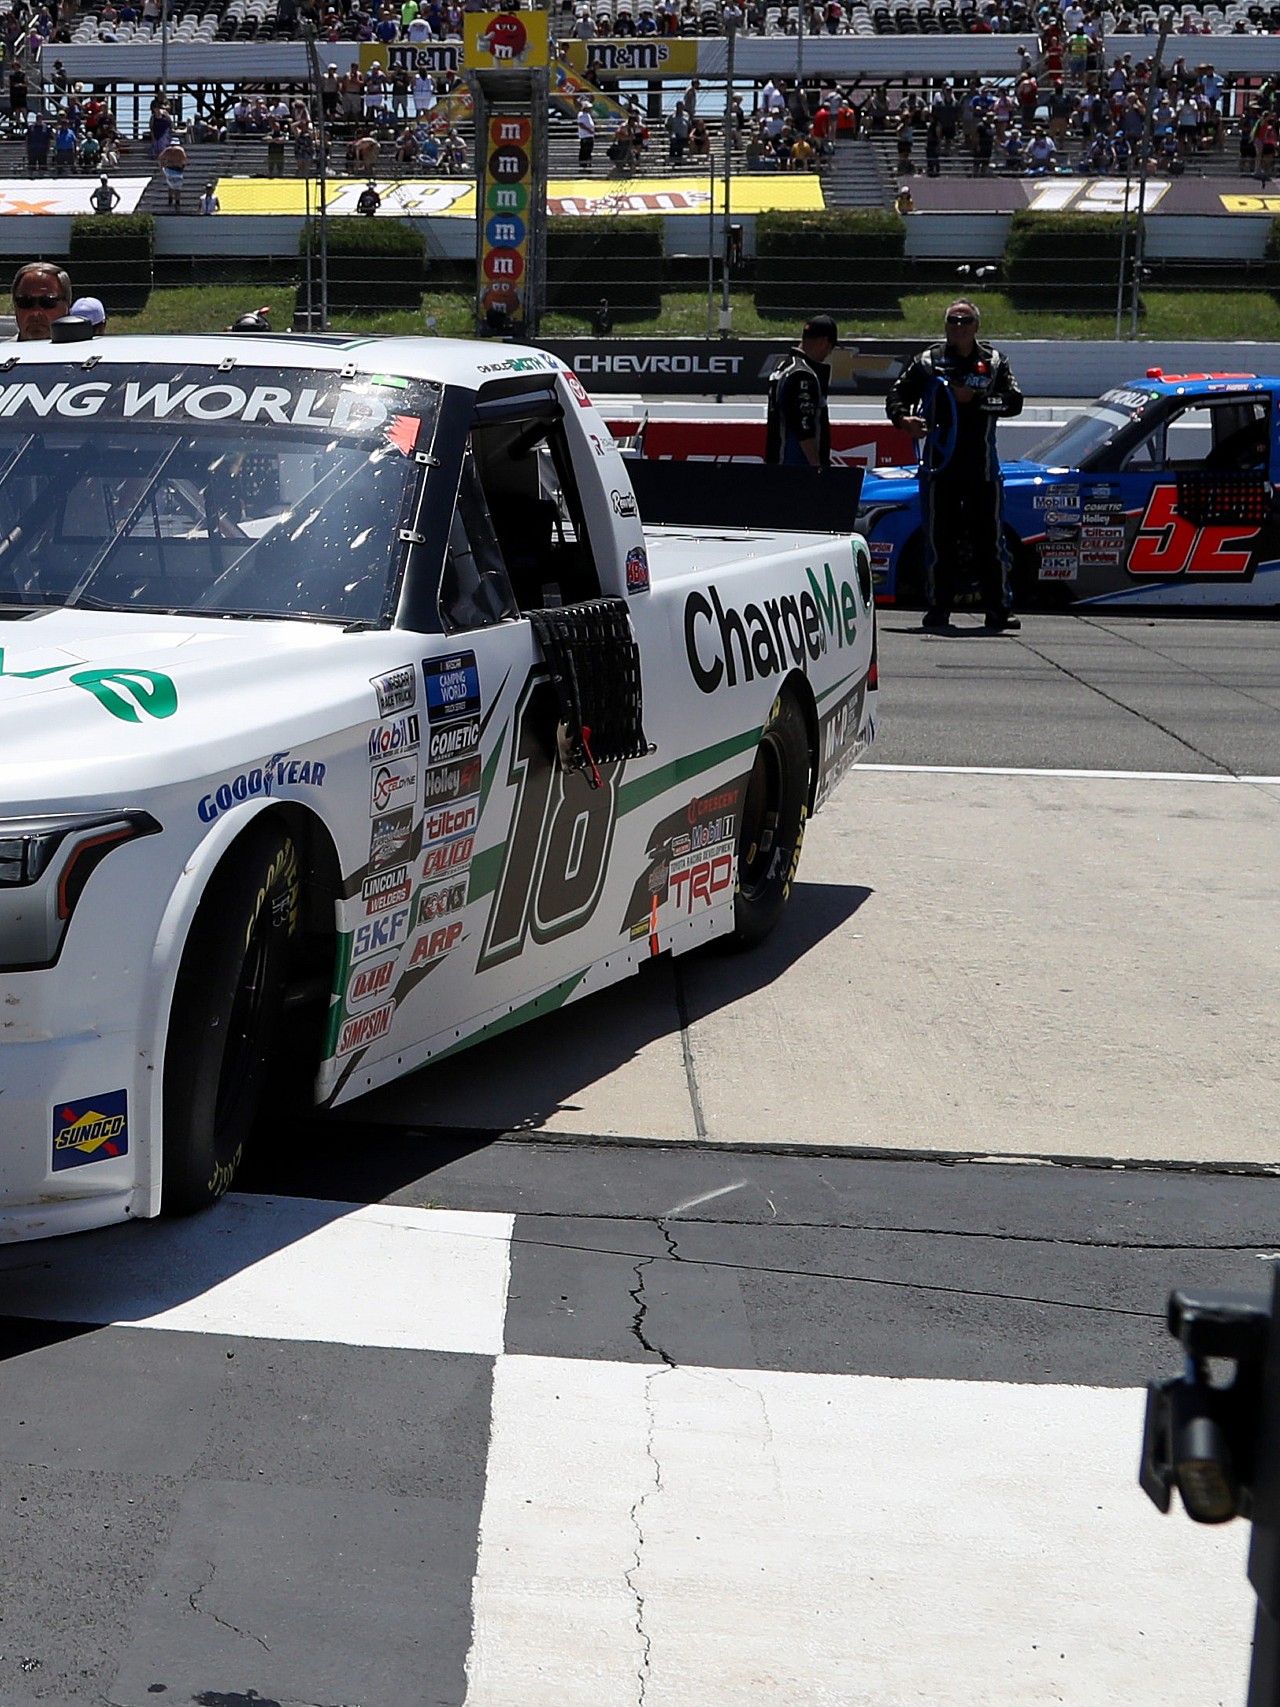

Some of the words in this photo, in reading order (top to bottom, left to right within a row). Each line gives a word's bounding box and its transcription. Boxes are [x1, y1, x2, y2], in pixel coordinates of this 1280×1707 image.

[586, 43, 669, 71] m&m's
[500, 123, 521, 140] m
[498, 156, 519, 173] m
[496, 190, 518, 207] m
[1029, 179, 1171, 211] 19
[494, 224, 516, 240] m
[492, 258, 514, 273] m
[573, 355, 744, 374] CHEVROLET
[119, 382, 389, 431] WORLD
[1129, 485, 1260, 574] 52
[439, 670, 466, 687] CAMPING
[441, 683, 468, 702] WORLD
[368, 718, 408, 756] Mobil
[430, 723, 480, 757] COMETIC
[425, 767, 461, 797] Holley
[426, 806, 476, 840] tilton
[691, 818, 722, 850] Mobil
[422, 835, 475, 879] CALICO
[363, 870, 406, 898] LINCOLN
[371, 888, 407, 912] WELDERS
[670, 854, 732, 914] TRD
[353, 908, 409, 957] SKF
[409, 921, 464, 966] ARP
[340, 1005, 394, 1052] SIMPSON
[57, 1116, 124, 1148] SUNOCO
